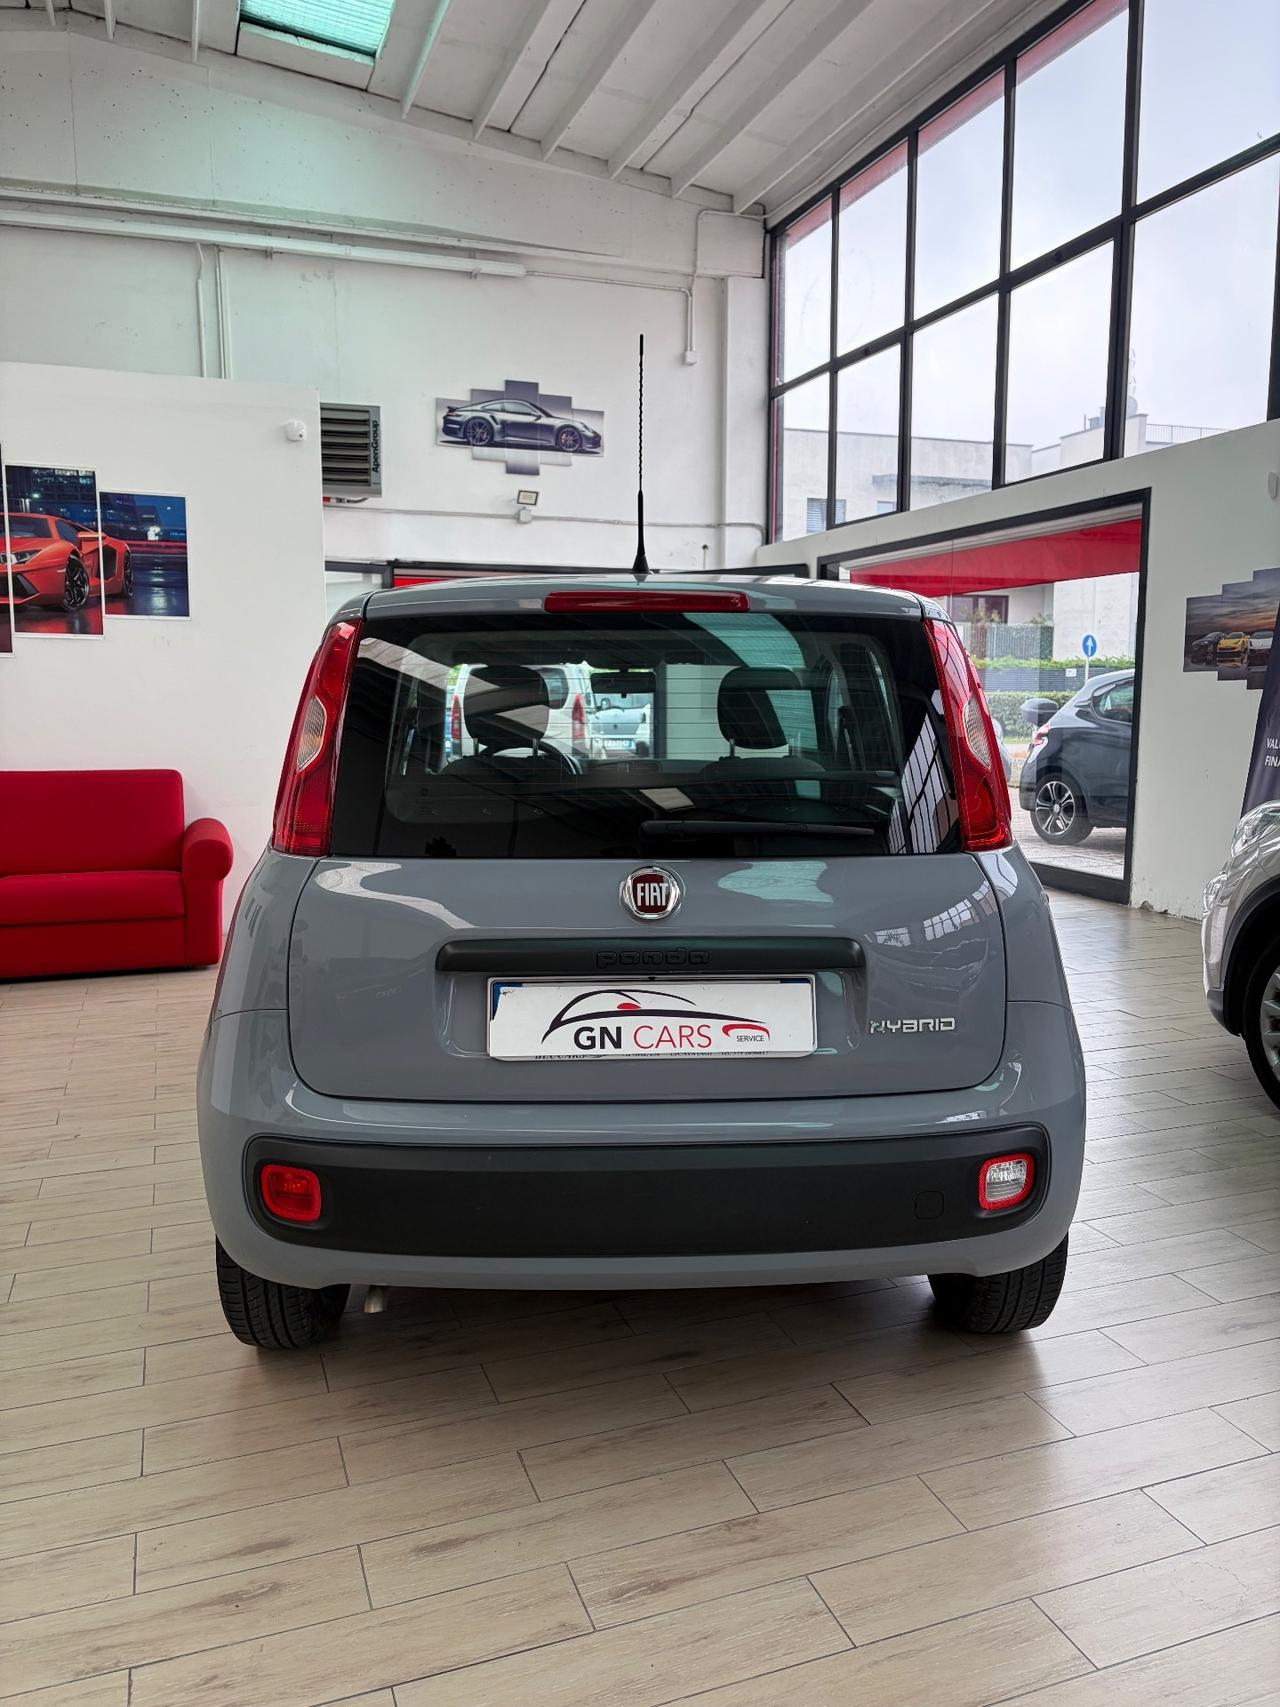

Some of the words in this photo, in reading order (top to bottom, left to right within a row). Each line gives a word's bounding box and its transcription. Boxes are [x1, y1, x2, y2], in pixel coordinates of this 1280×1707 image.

[1266, 738, 1280, 749] VAL
[636, 883, 668, 906] FIAT
[596, 947, 710, 968] panda
[870, 1017, 955, 1034] HYBRID
[573, 1026, 622, 1050] GN
[633, 1024, 712, 1049] CARS
[736, 1035, 765, 1043] SERVICE
